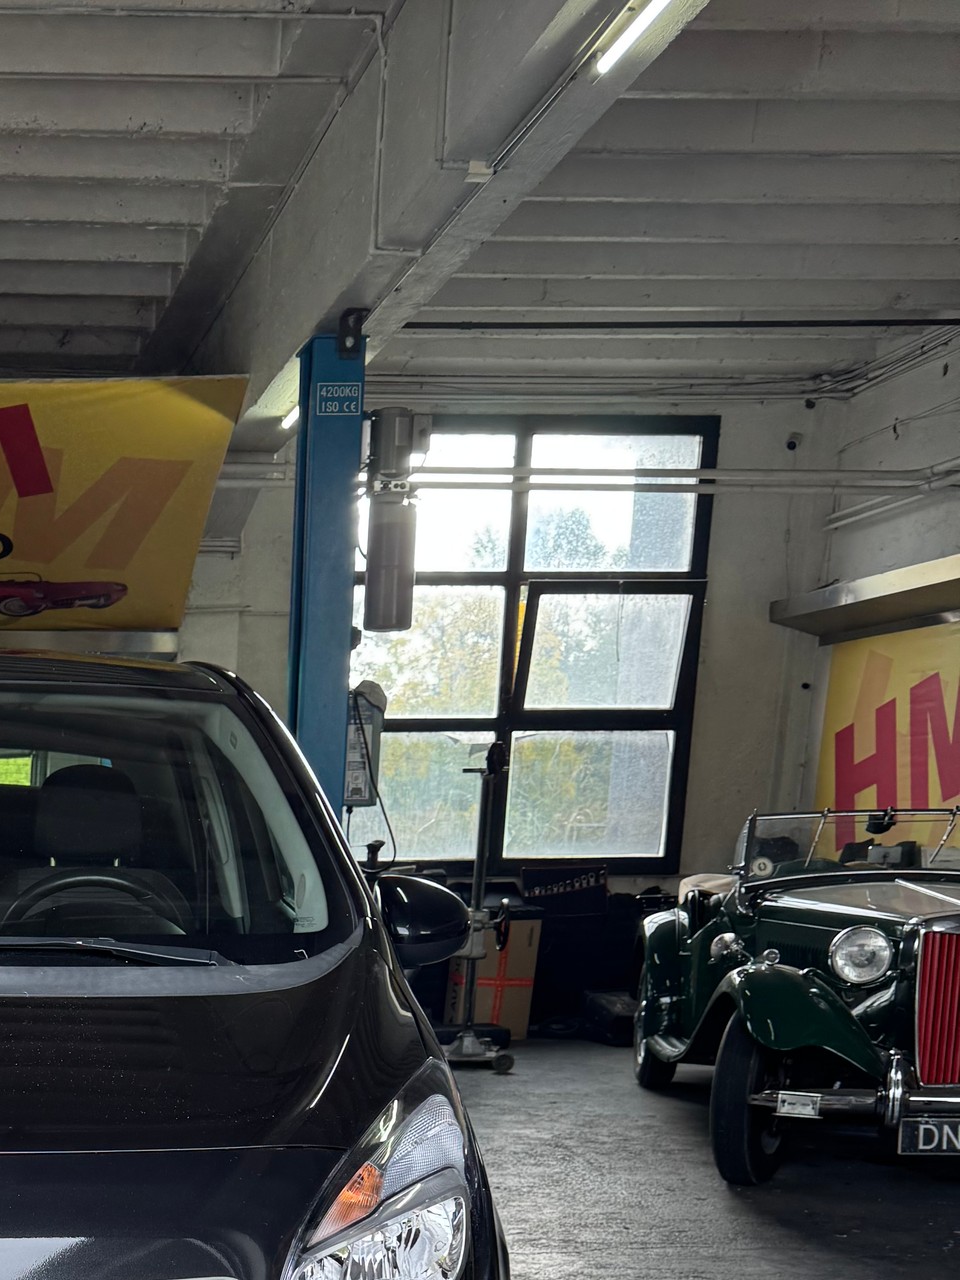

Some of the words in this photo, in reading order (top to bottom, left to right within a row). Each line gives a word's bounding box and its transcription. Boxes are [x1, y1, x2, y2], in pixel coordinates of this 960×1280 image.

[320, 386, 358, 397] 4200KG
[321, 401, 339, 412] ISO
[918, 1124, 960, 1150] DN
